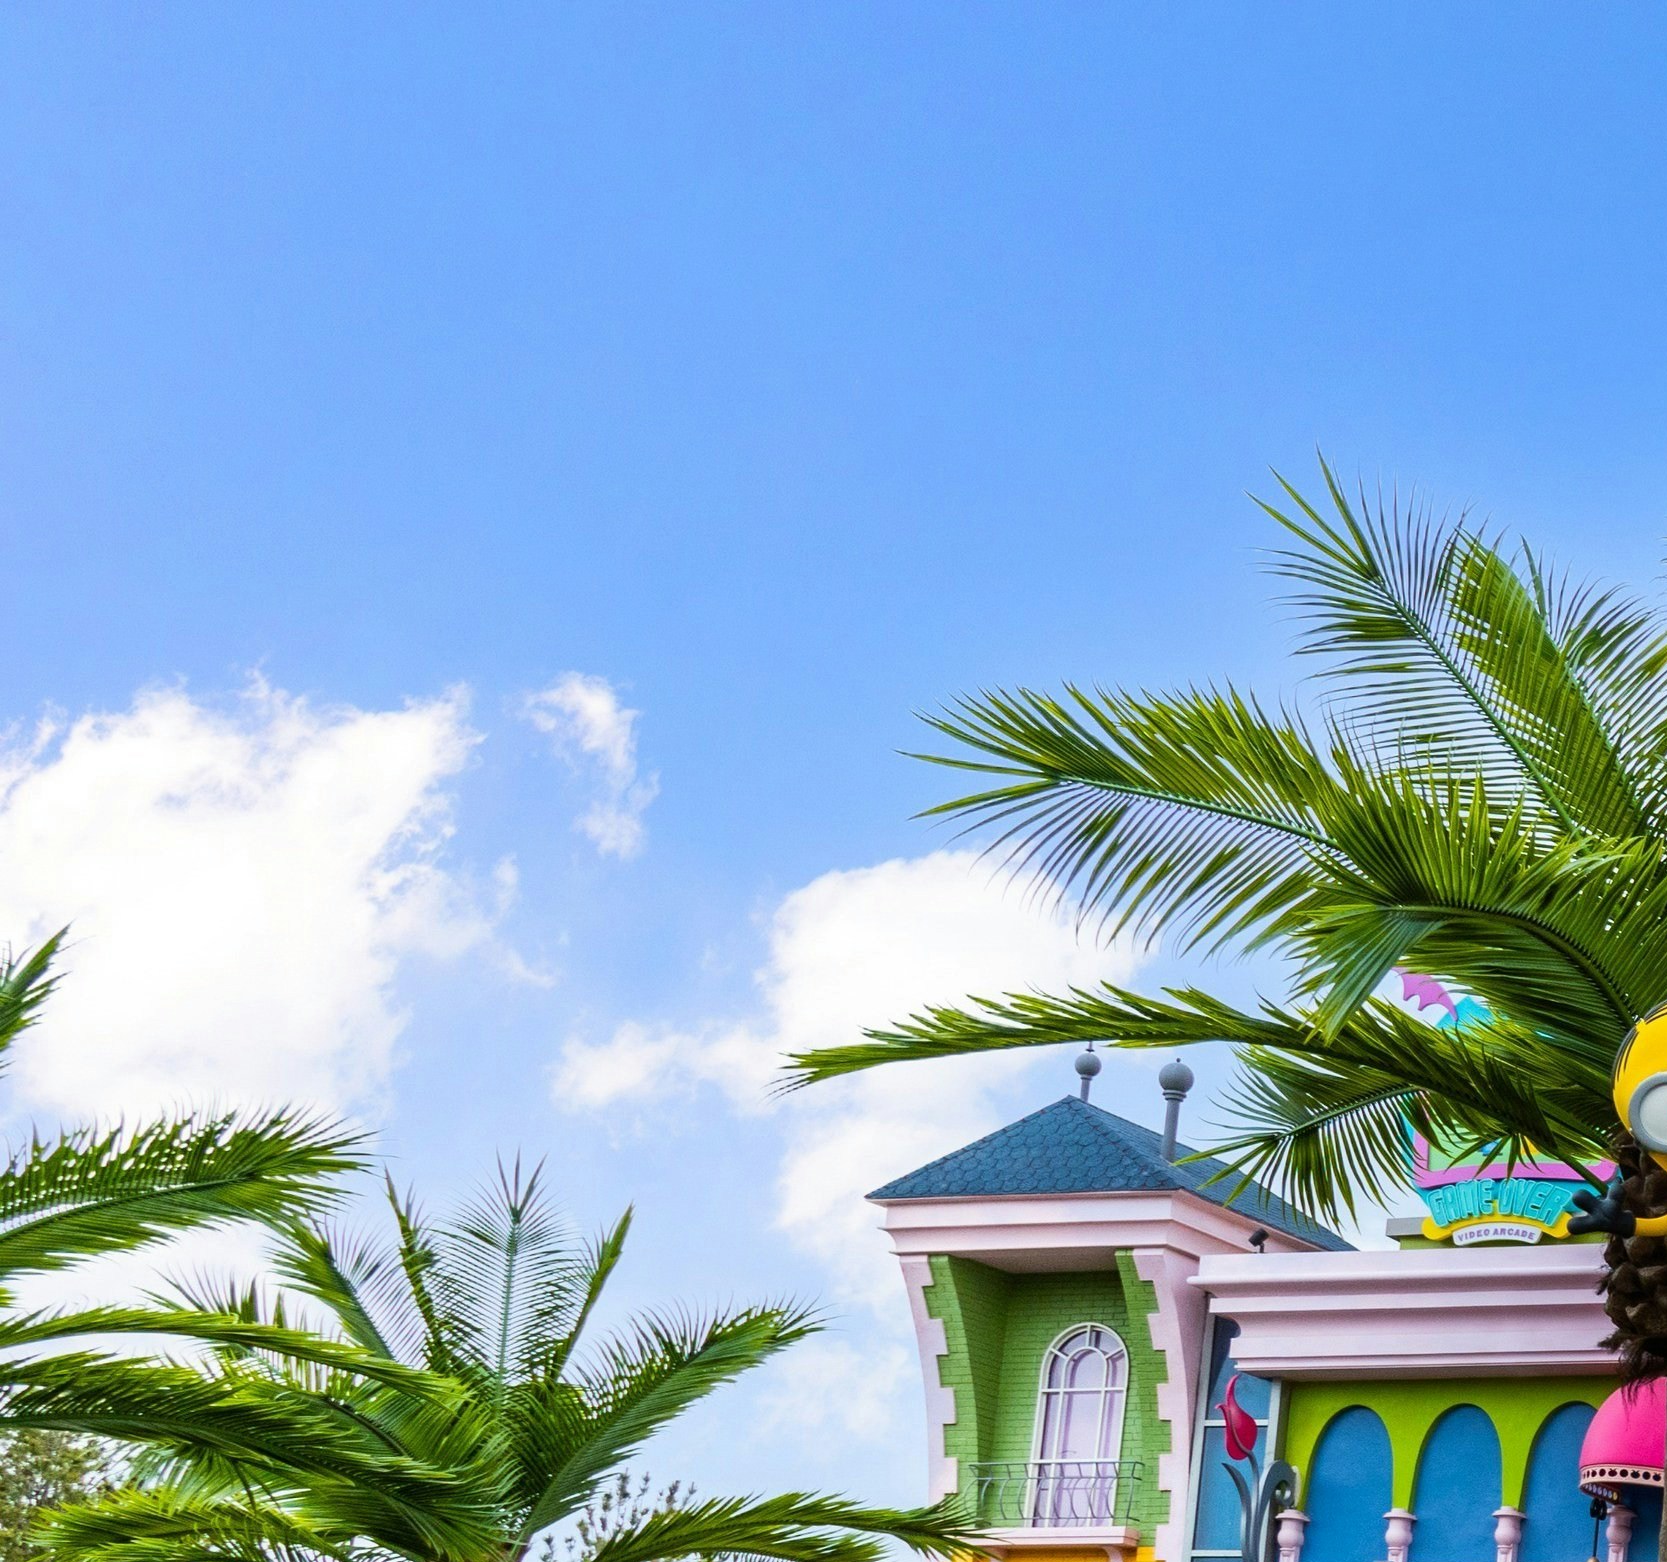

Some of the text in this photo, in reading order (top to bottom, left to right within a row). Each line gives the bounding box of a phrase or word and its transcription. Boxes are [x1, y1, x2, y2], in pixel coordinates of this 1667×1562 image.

[1427, 1177, 1573, 1228] GAME OVER
[1458, 1228, 1536, 1242] VIDEO ARCADE
